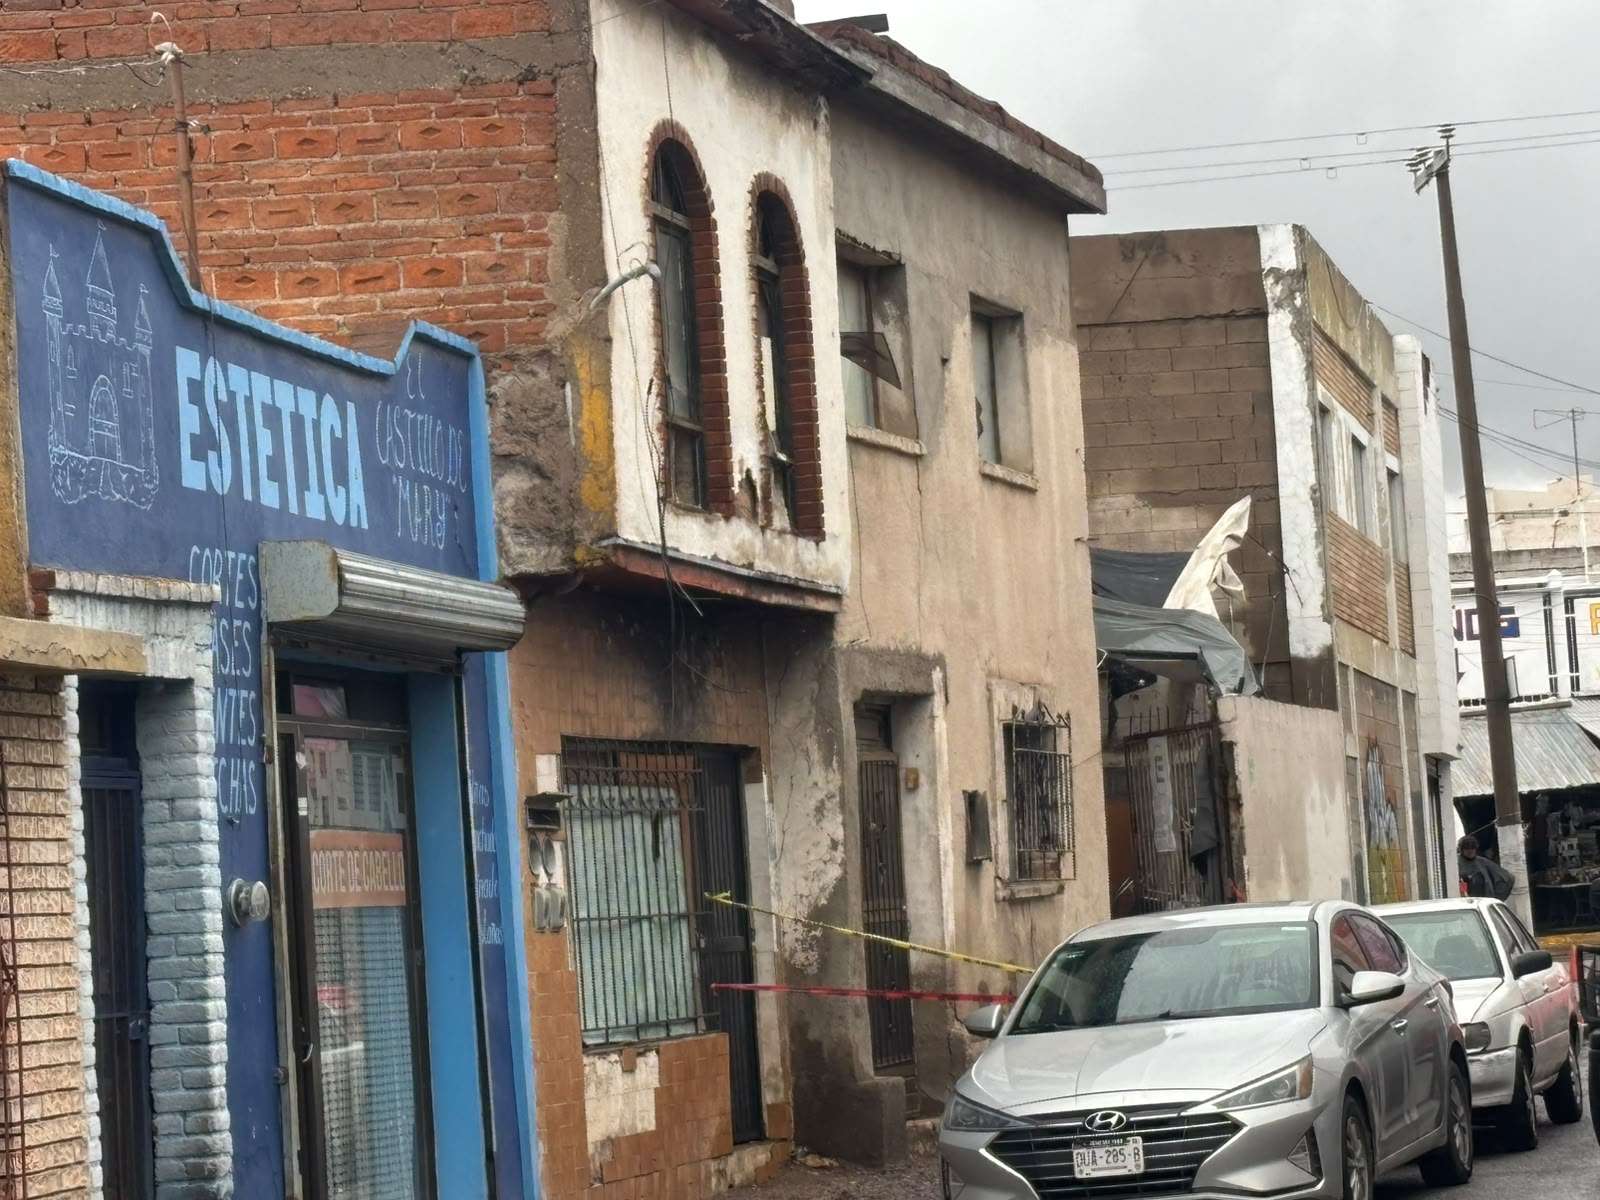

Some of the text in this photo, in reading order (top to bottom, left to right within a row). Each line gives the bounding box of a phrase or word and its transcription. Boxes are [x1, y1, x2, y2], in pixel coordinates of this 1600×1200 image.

[175, 345, 368, 530] ESTETICA
[211, 617, 252, 678] ASES
[215, 687, 256, 747] NTES
[215, 756, 257, 815] CHAS
